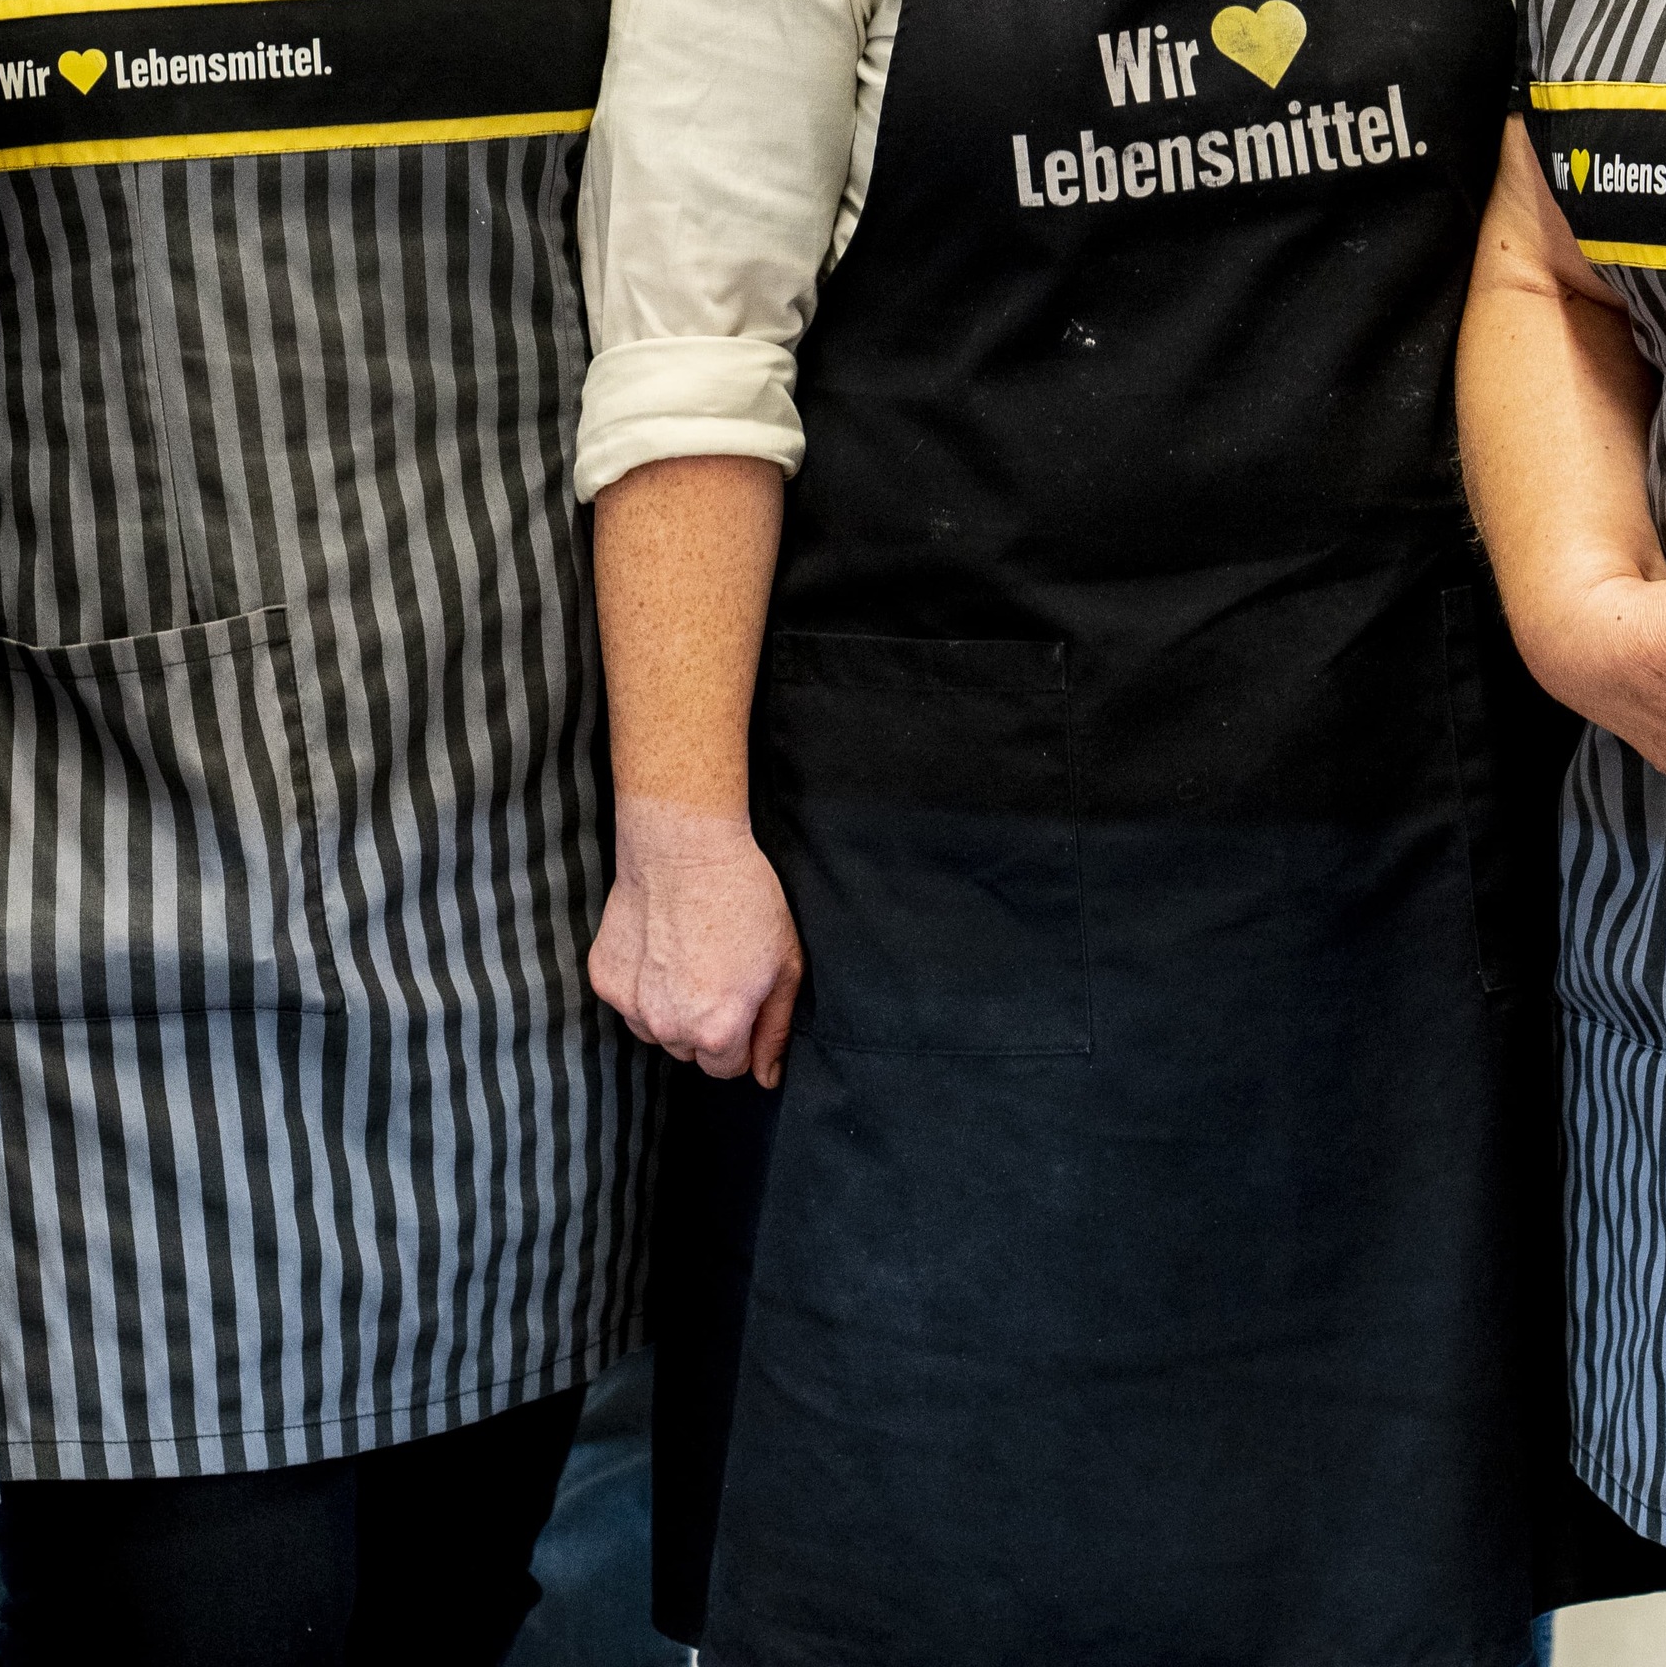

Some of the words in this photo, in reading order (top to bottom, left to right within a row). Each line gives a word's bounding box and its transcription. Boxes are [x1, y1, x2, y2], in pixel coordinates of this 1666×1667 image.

[114, 37, 333, 90] Lebensmittel.
[1097, 24, 1200, 107] Wir
[1012, 84, 1428, 208] Lebensmittel.
